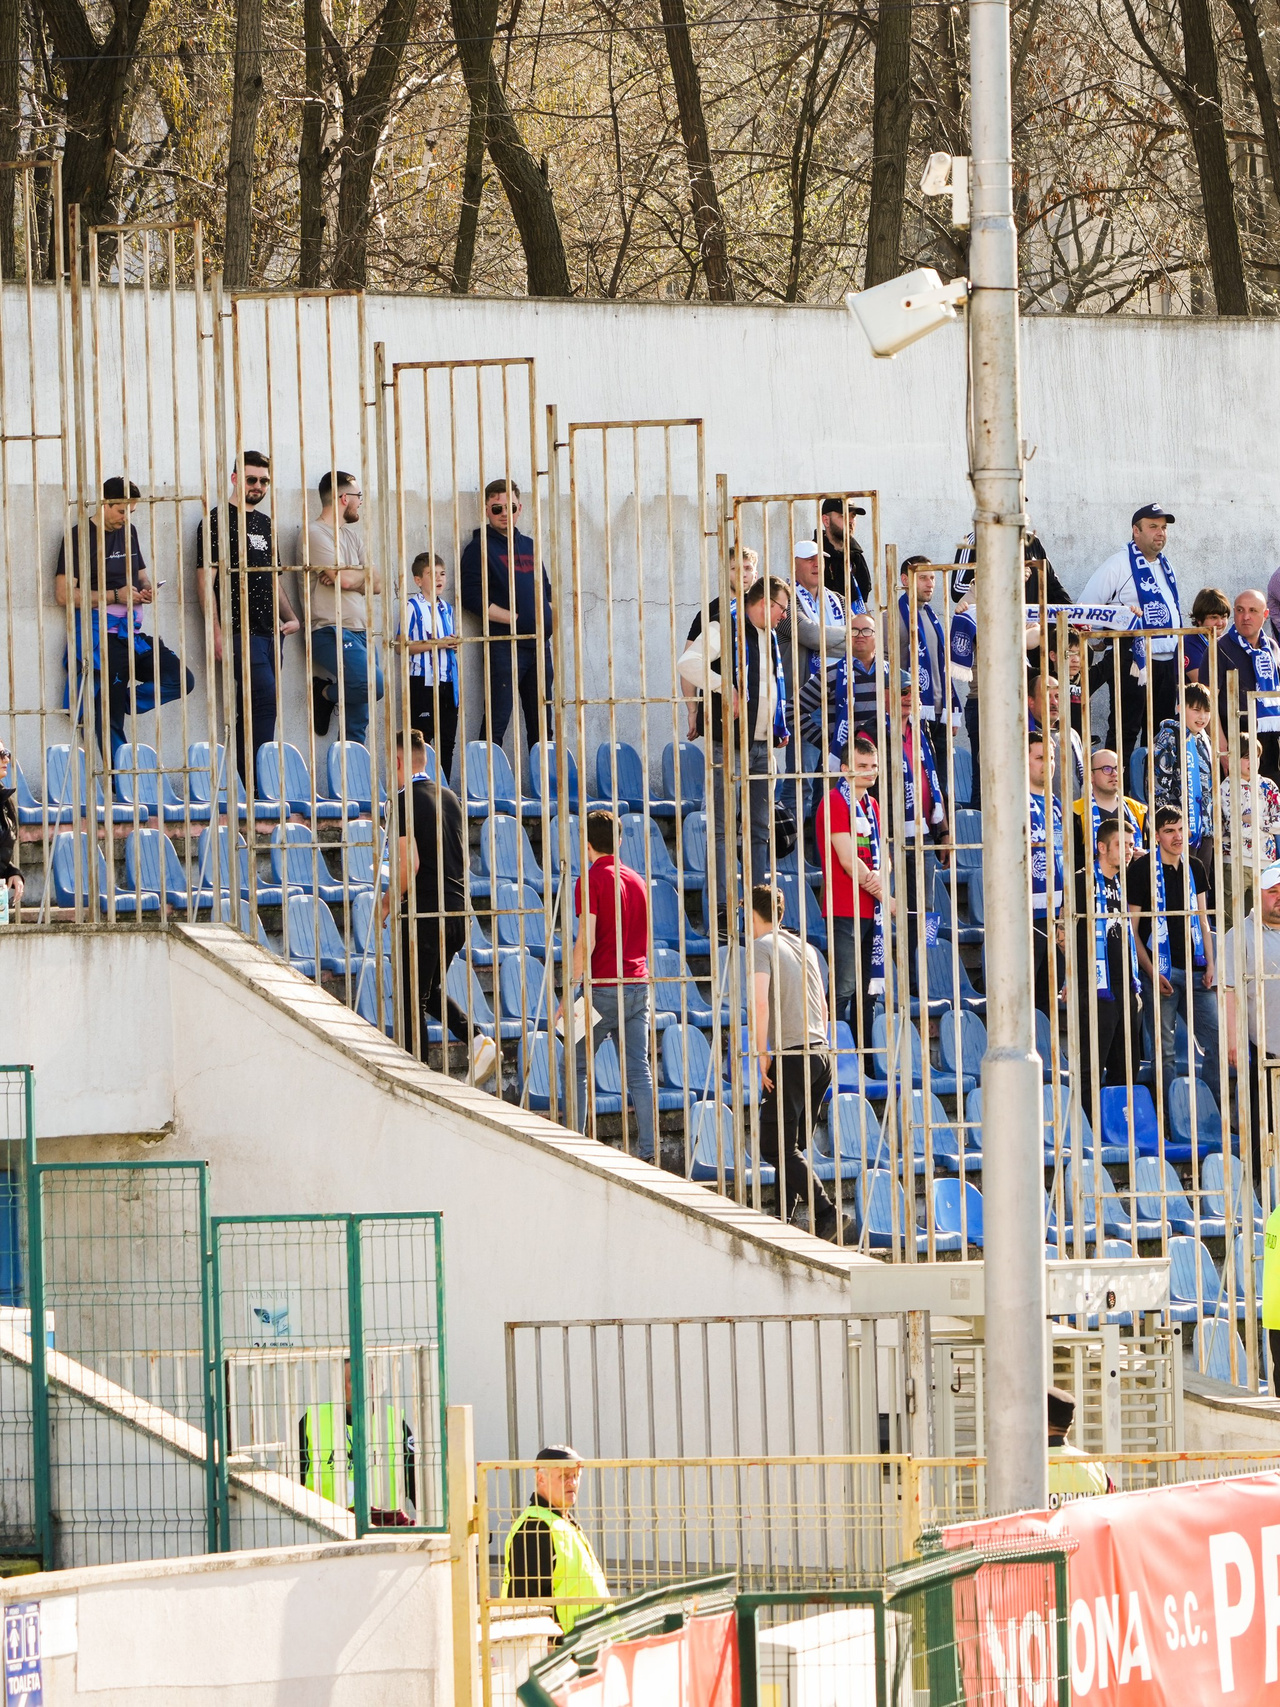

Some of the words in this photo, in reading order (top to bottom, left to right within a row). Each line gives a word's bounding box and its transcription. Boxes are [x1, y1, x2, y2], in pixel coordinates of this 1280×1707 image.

[1187, 771, 1195, 816] MOZZART
[1188, 816, 1196, 834] BET
[1164, 1590, 1208, 1651] S.C.
[8, 1672, 41, 1695] TOALETA
